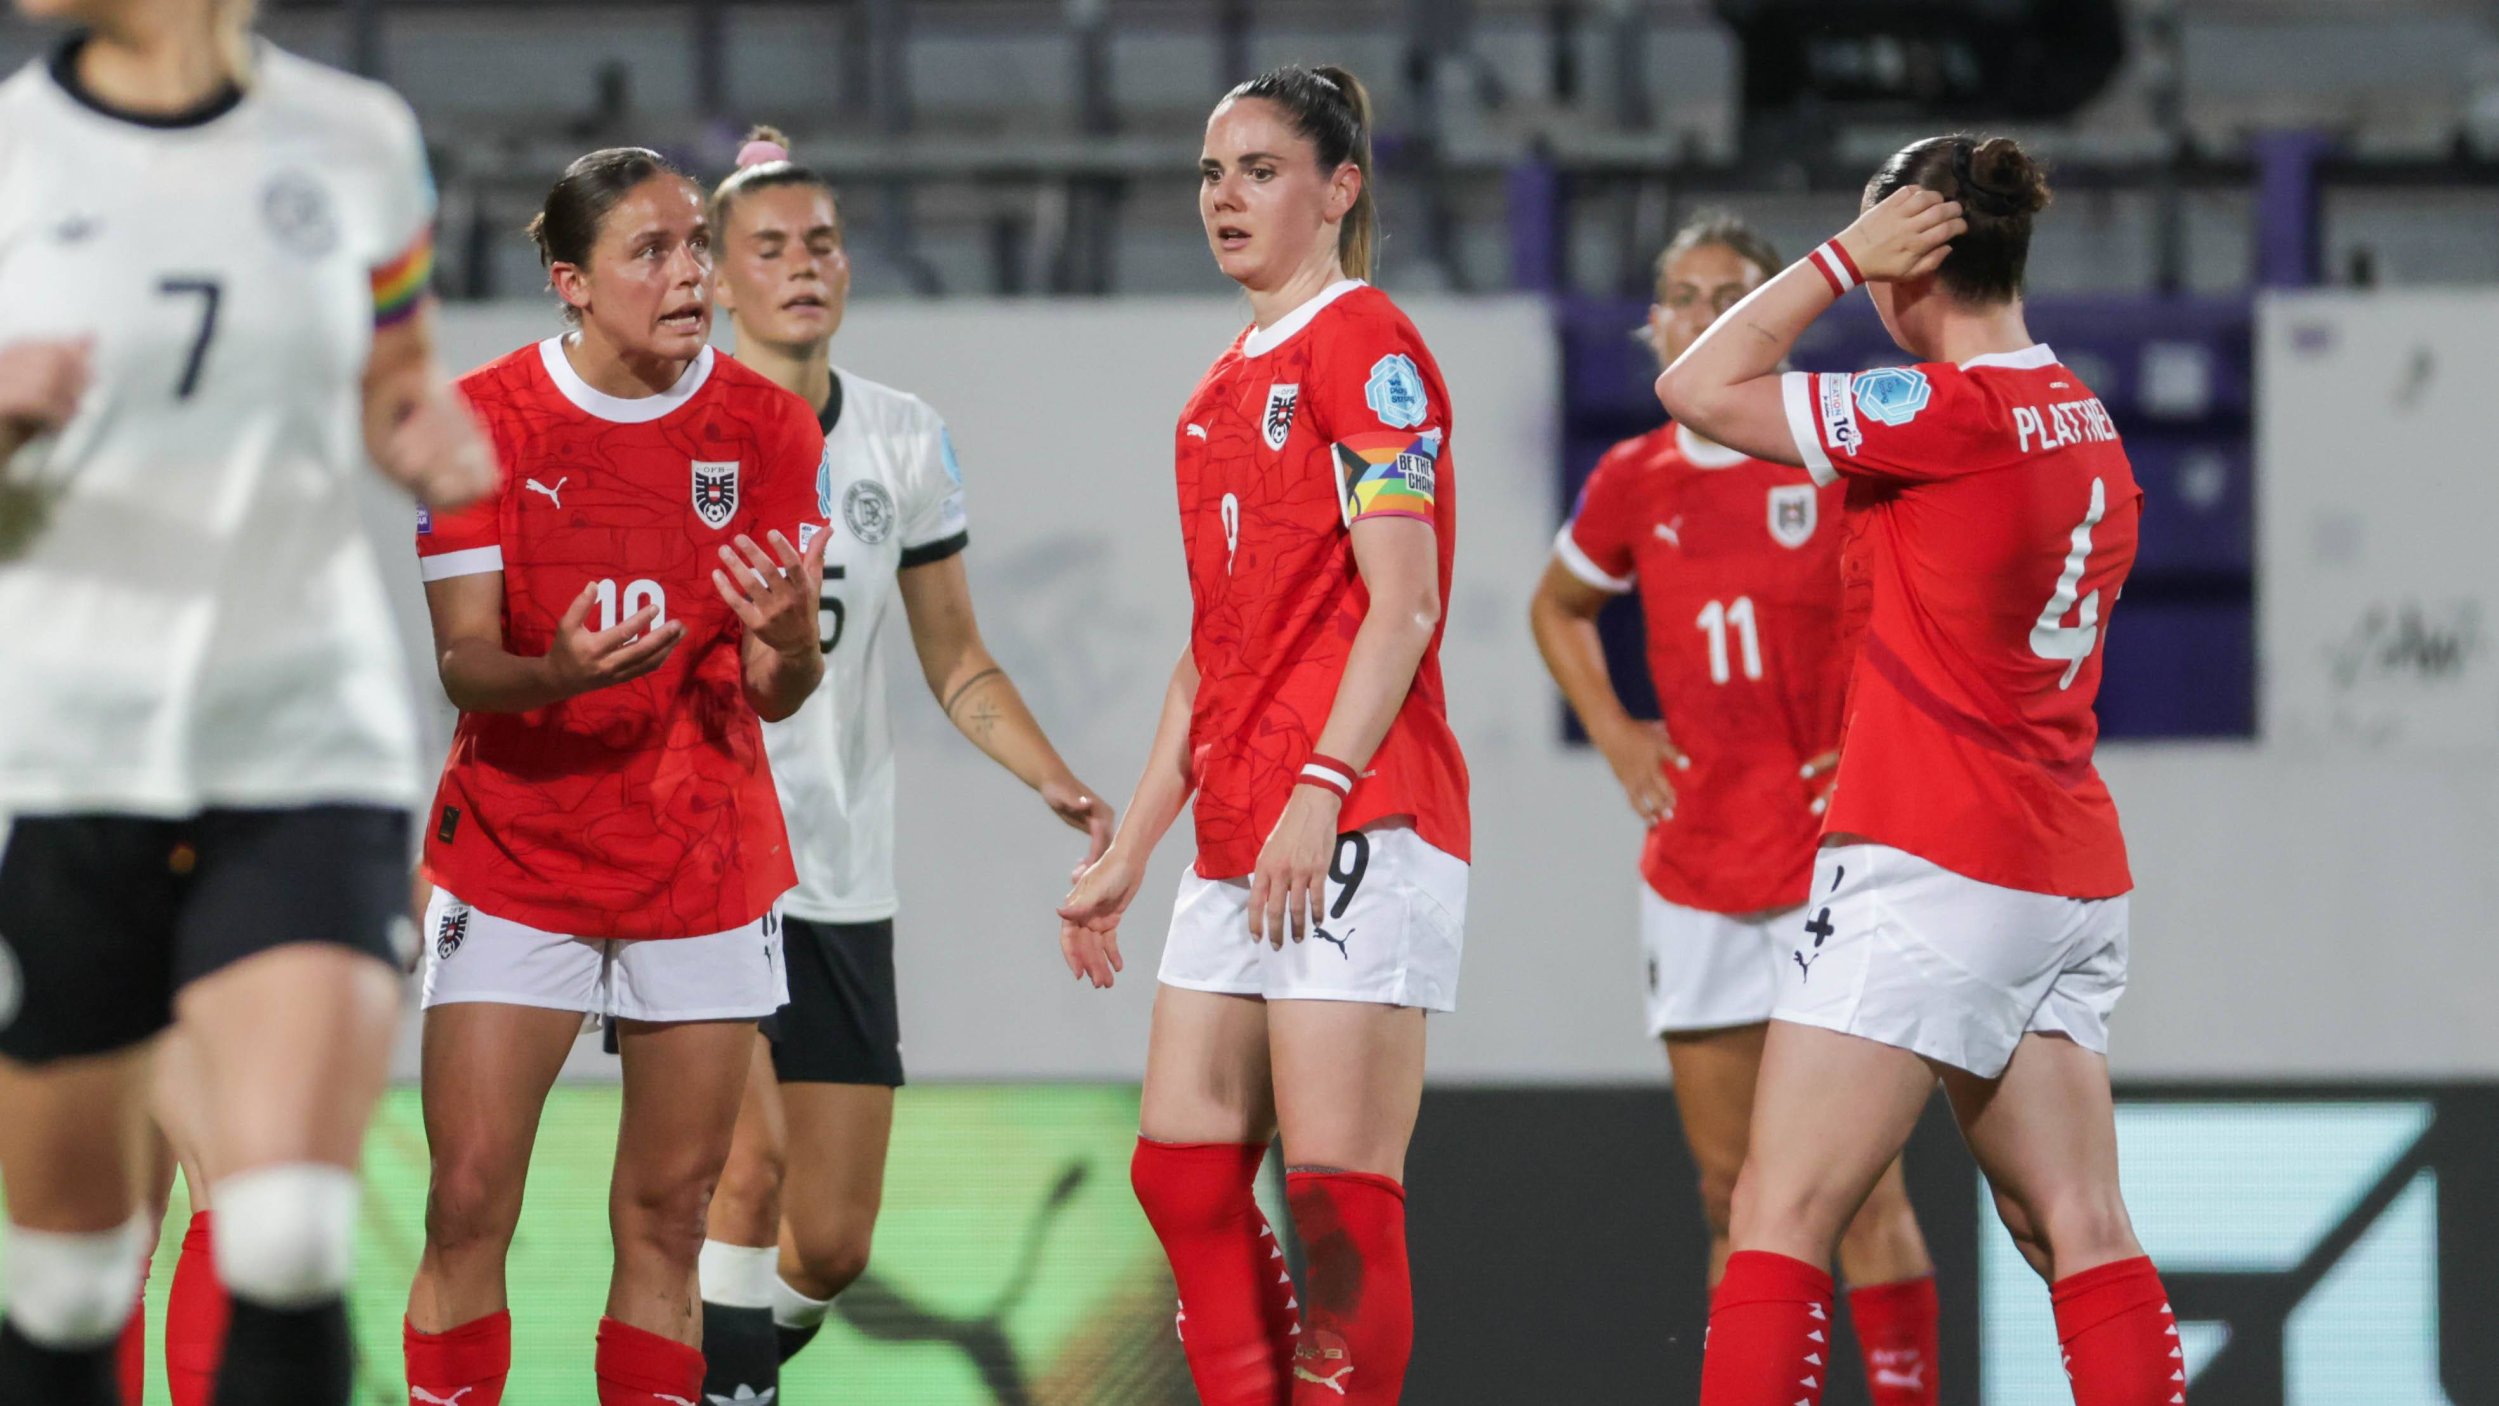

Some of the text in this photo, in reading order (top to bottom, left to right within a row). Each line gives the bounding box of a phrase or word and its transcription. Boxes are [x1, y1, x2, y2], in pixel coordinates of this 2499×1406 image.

[156, 278, 219, 402] 7
[1398, 454, 1430, 477] BE THE
[2012, 397, 2118, 453] PLATTNE
[1220, 492, 1239, 577] 9
[592, 578, 665, 646] 10
[2027, 475, 2106, 691] 4
[1695, 595, 1763, 685] 11
[1327, 830, 1370, 920] 9
